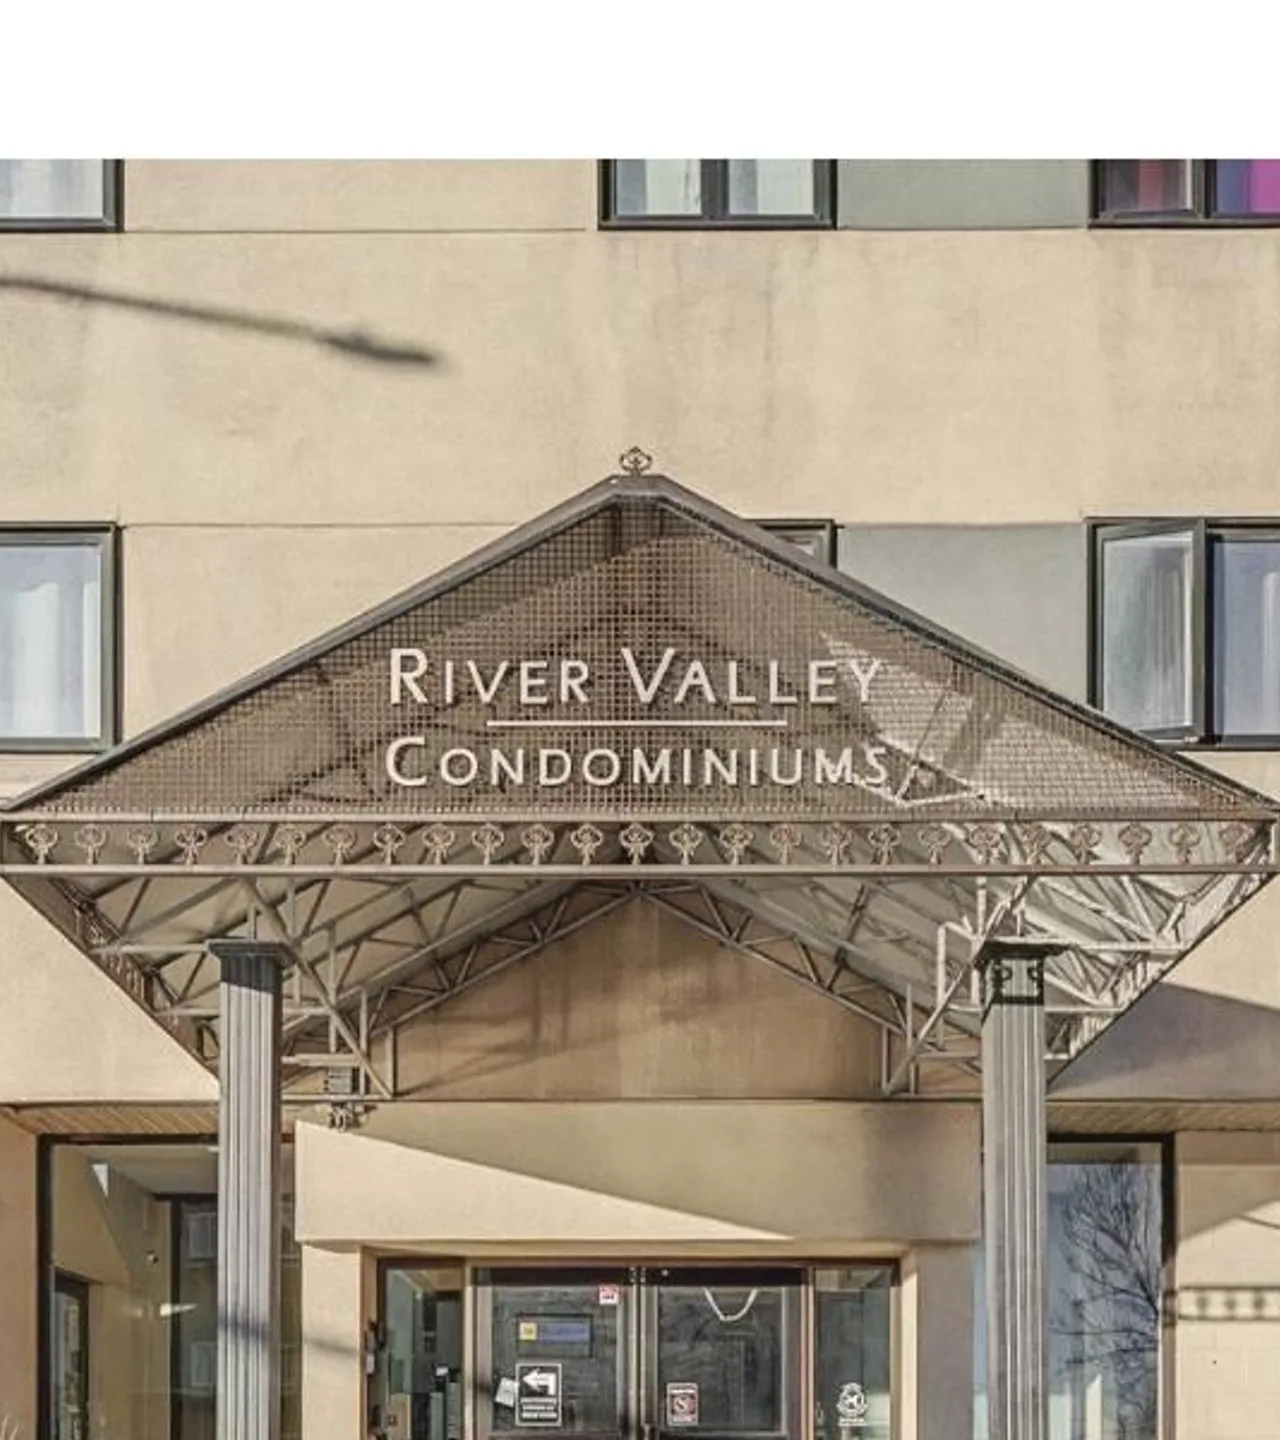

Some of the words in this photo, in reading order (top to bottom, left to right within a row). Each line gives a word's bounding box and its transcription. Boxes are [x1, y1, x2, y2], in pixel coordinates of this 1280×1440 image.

[387, 646, 589, 705] RIVER
[621, 647, 882, 704] VALLEY
[384, 735, 889, 787] CONDOMINIUMS
